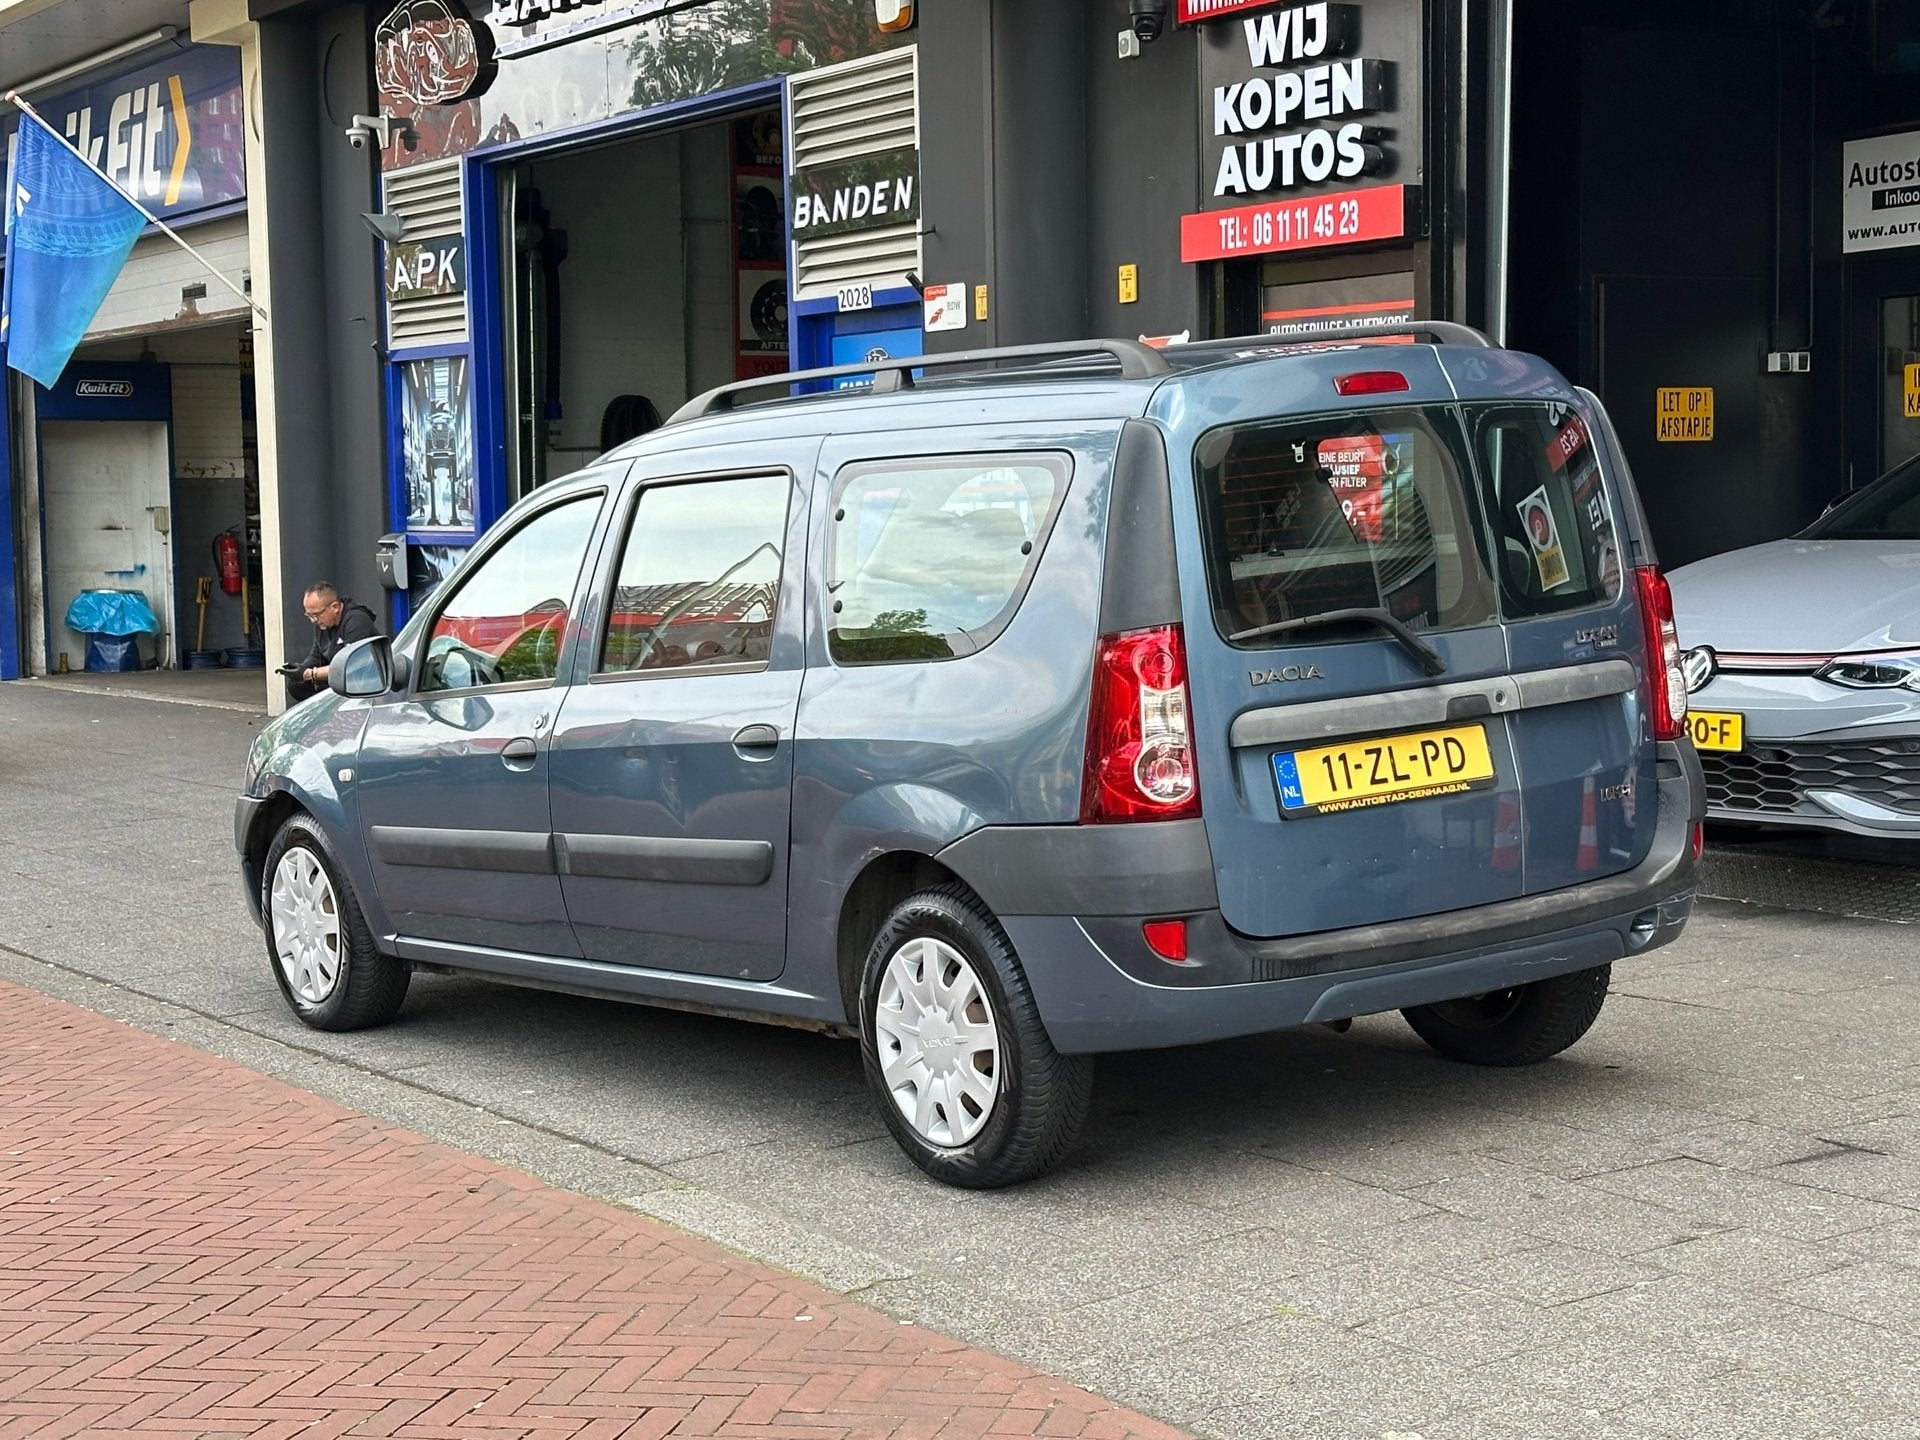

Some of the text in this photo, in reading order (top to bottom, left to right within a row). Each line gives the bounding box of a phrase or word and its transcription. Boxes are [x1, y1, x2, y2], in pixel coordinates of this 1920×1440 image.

[1243, 2, 1328, 67] WIJ
[1214, 58, 1364, 136] KOPEN
[1213, 123, 1366, 197] AUTOS
[793, 176, 914, 229] BANDEN
[1219, 199, 1359, 250] TEL: 06 11 11 45 23
[1848, 222, 1920, 240] WWW.AUT
[393, 247, 458, 292] APK
[839, 286, 869, 308] 2028
[761, 341, 789, 350] AFTE
[1662, 391, 1707, 412] LET OP!
[1660, 417, 1711, 438] AFSTAPJE
[1340, 476, 1367, 488] FILTER
[1249, 664, 1326, 686] DACIA
[1322, 737, 1466, 792] 11-ZL-PD
[1284, 786, 1300, 799] NL
